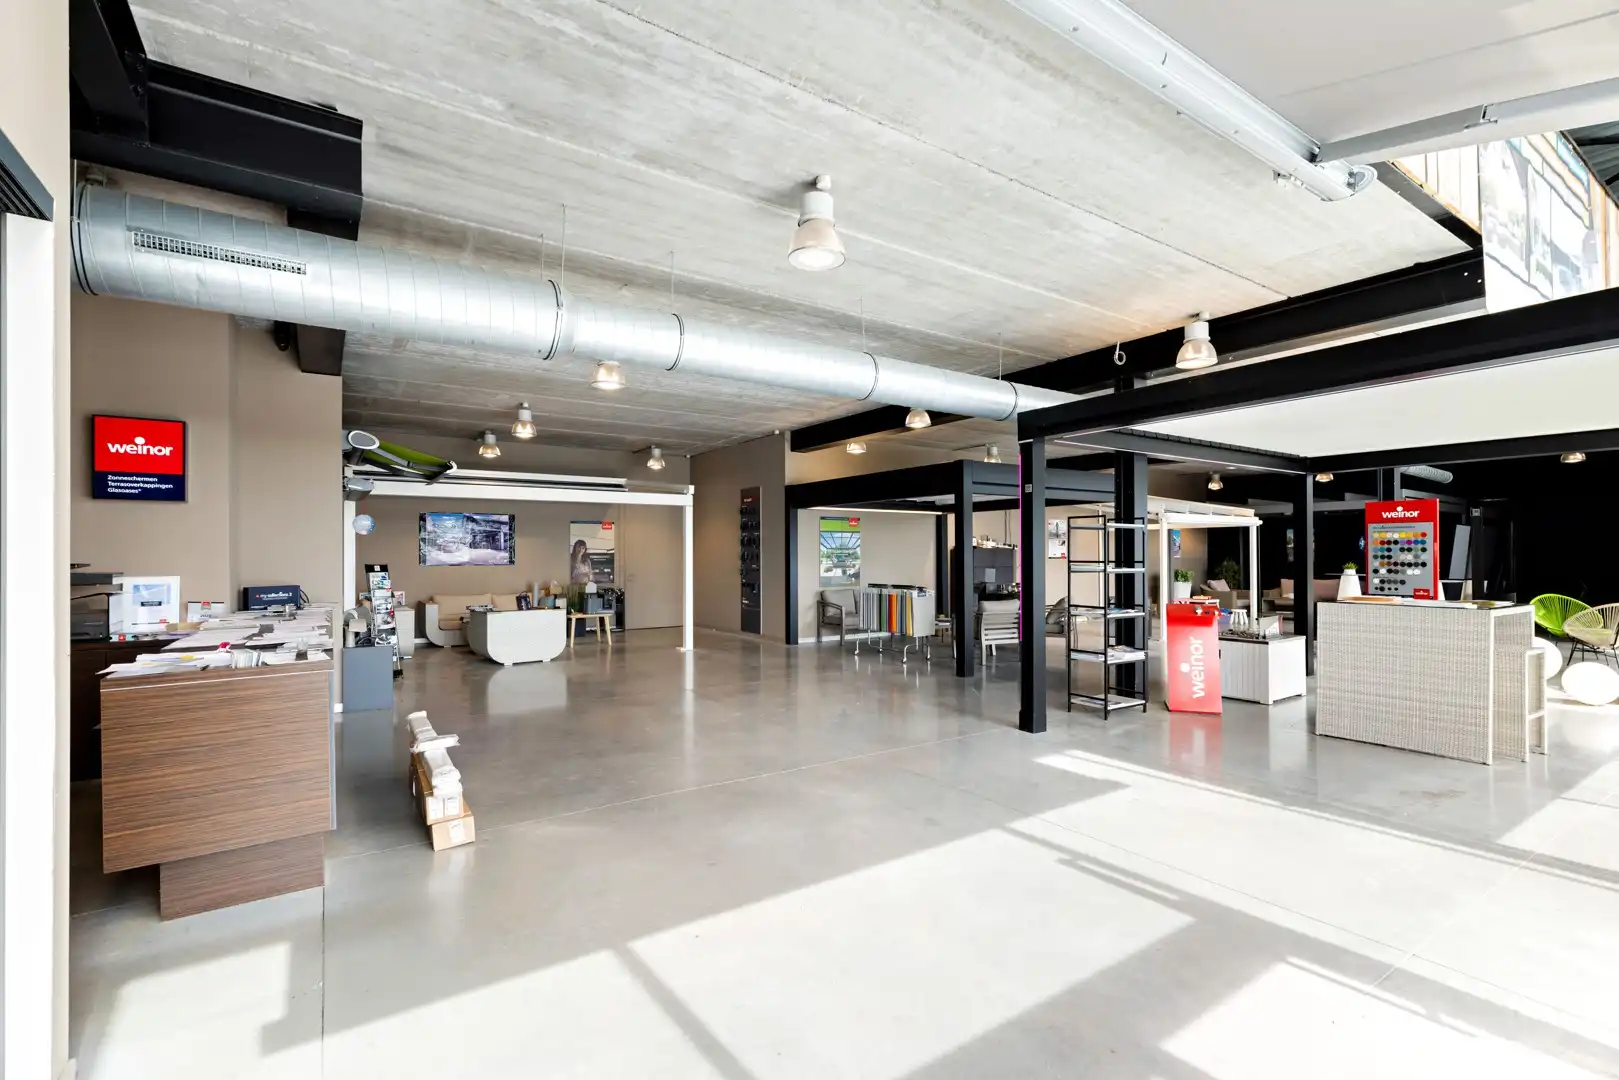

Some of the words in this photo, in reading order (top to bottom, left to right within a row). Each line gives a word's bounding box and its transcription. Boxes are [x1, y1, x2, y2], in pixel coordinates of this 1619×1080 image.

[107, 436, 173, 456] weinor
[107, 474, 158, 482] Zonneschermen
[107, 481, 173, 489] Terrasoverkappingen
[1381, 506, 1420, 518] weinor
[1180, 636, 1205, 699] weinor
